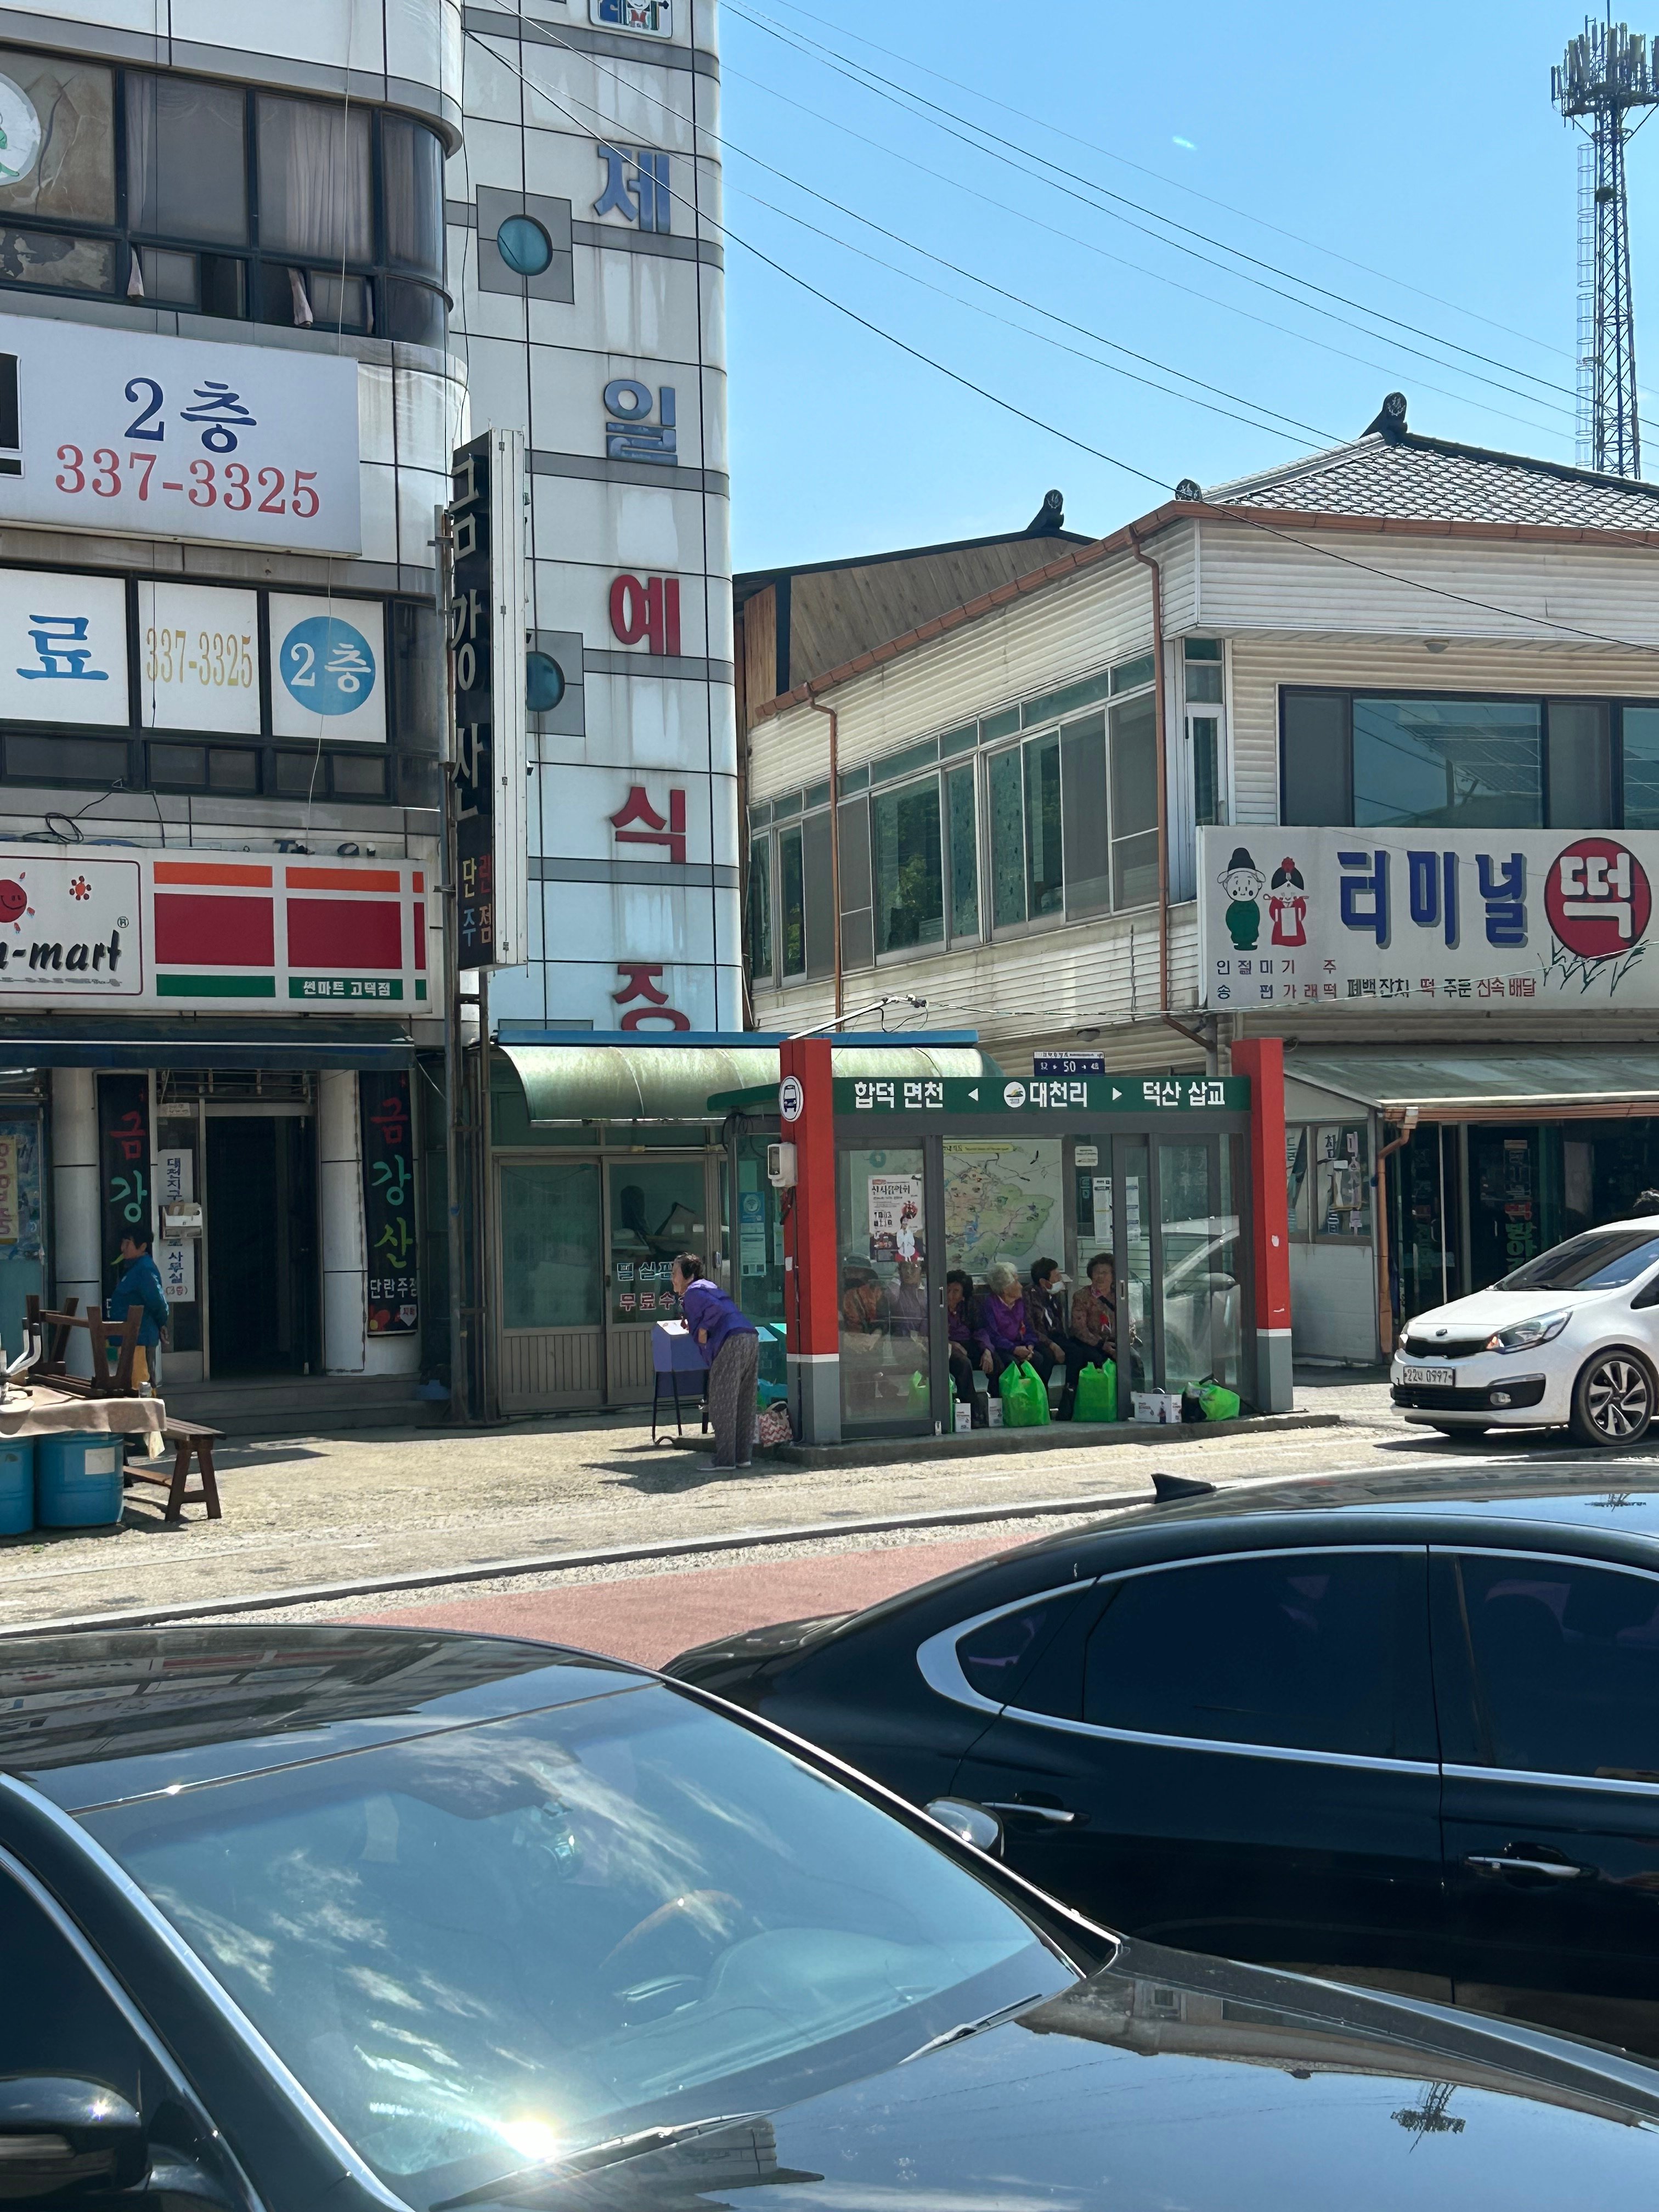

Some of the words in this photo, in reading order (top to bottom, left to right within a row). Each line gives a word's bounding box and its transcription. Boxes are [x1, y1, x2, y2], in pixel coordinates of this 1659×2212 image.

[124, 377, 257, 454] 2층
[55, 444, 320, 518] 337-3325
[16, 614, 109, 680] 료
[146, 628, 253, 688] 337-3325
[290, 642, 371, 693] 2층
[449, 453, 483, 821] 금강산
[1337, 850, 1530, 950] 터미널
[1560, 852, 1633, 940] 떡
[1509, 978, 1537, 997] 배달
[854, 1081, 895, 1108] 합덕
[904, 1081, 944, 1108] 면천
[1029, 1081, 1088, 1108] 대천리
[1143, 1081, 1182, 1107] 덕산
[1188, 1081, 1226, 1107] 삽교
[1063, 1060, 1076, 1073] 50
[110, 1110, 148, 1265] 금강
[370, 1097, 412, 1268] 금강산
[619, 1291, 684, 1312] 무료수
